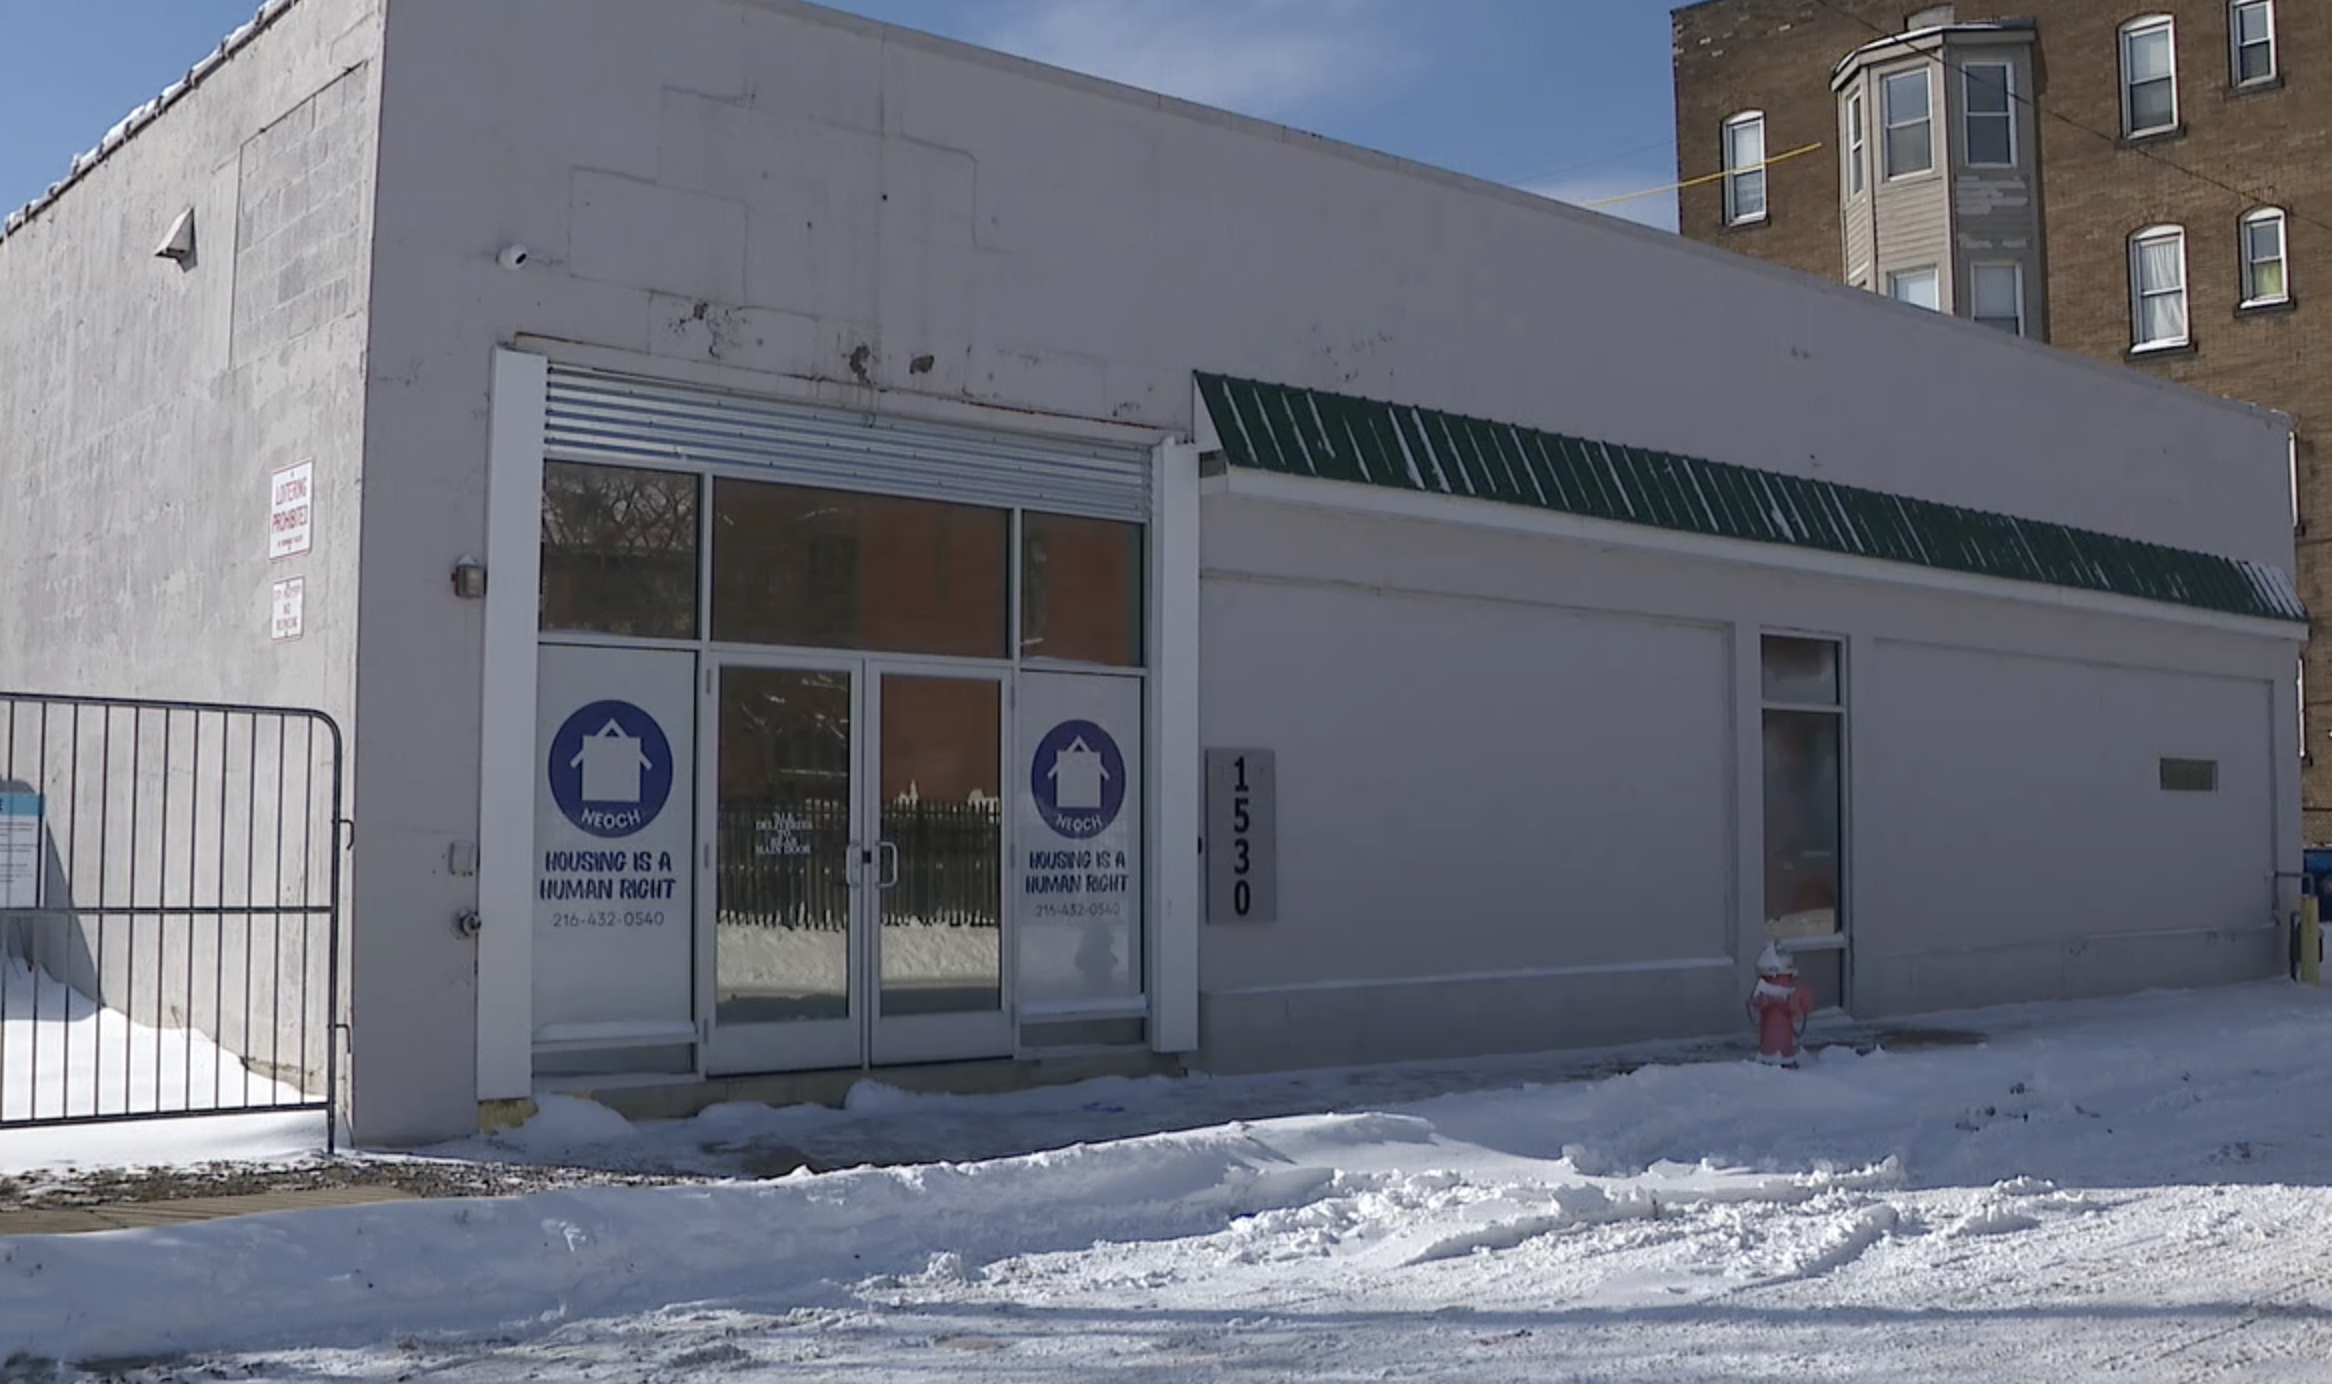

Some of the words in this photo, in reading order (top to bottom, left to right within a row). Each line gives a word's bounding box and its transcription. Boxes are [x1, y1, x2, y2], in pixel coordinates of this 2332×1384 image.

[271, 503, 309, 534] PROHIBITED
[581, 808, 641, 829] NEOCH
[1055, 813, 1102, 832] NEOCH
[1234, 756, 1251, 917] 1530
[545, 851, 628, 873] HOUSING
[633, 851, 651, 873] IS
[658, 851, 672, 872] A
[1029, 850, 1091, 870] HOUSING
[1096, 850, 1111, 869] IS
[1115, 850, 1126, 869] A
[540, 878, 614, 900] HUMAN
[619, 878, 676, 900] RIGHT
[1025, 874, 1082, 894] HUMAN
[1085, 874, 1130, 894] RIGHT
[553, 911, 665, 927] 216-432-0540
[1035, 903, 1121, 918] 216-432-0540
